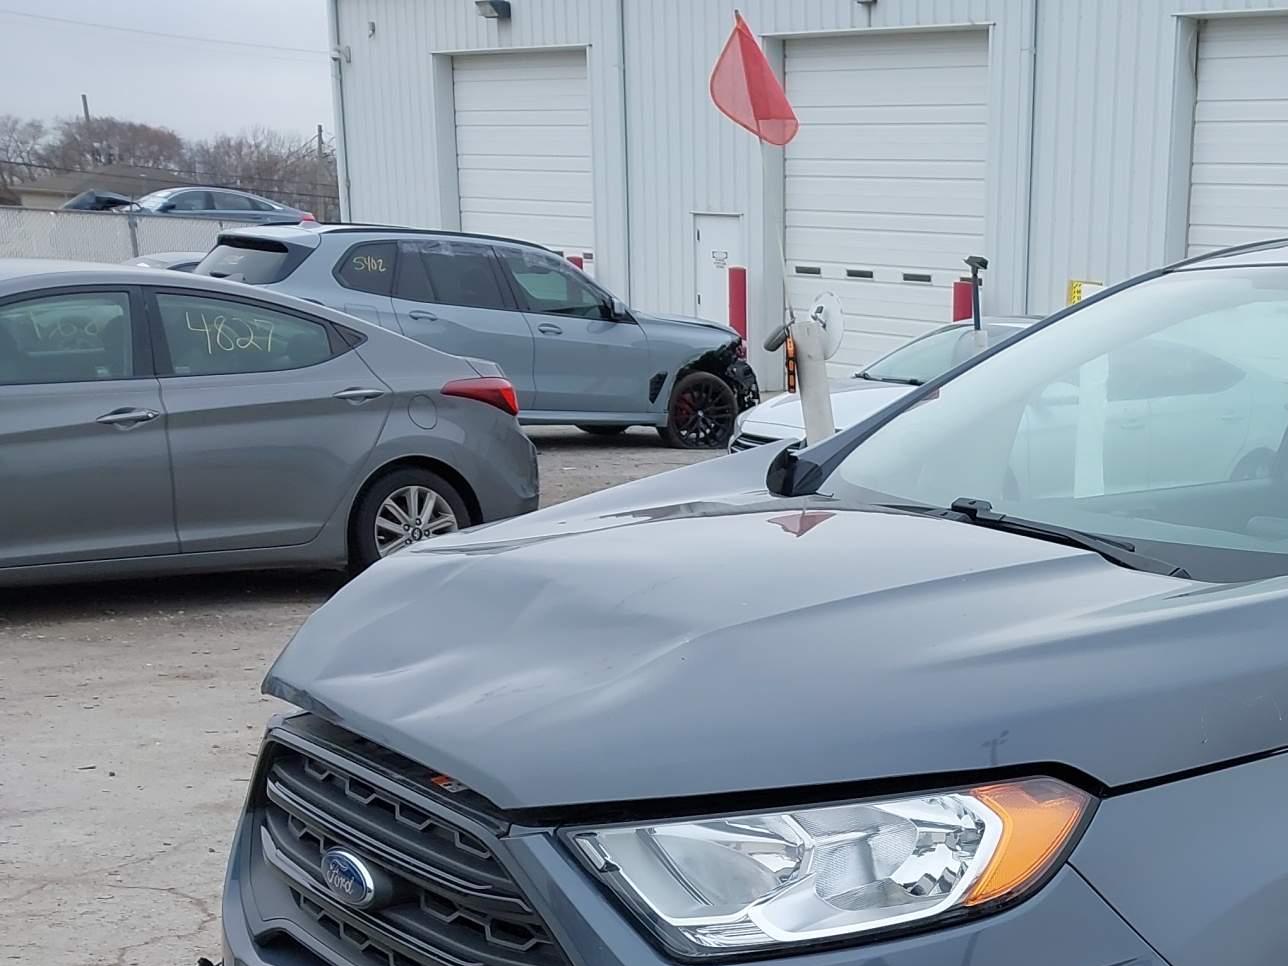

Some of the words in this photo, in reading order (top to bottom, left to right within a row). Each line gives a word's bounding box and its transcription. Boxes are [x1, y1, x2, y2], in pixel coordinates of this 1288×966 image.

[352, 255, 387, 272] 5402
[185, 310, 275, 354] 4827
[326, 859, 355, 895] Ford
